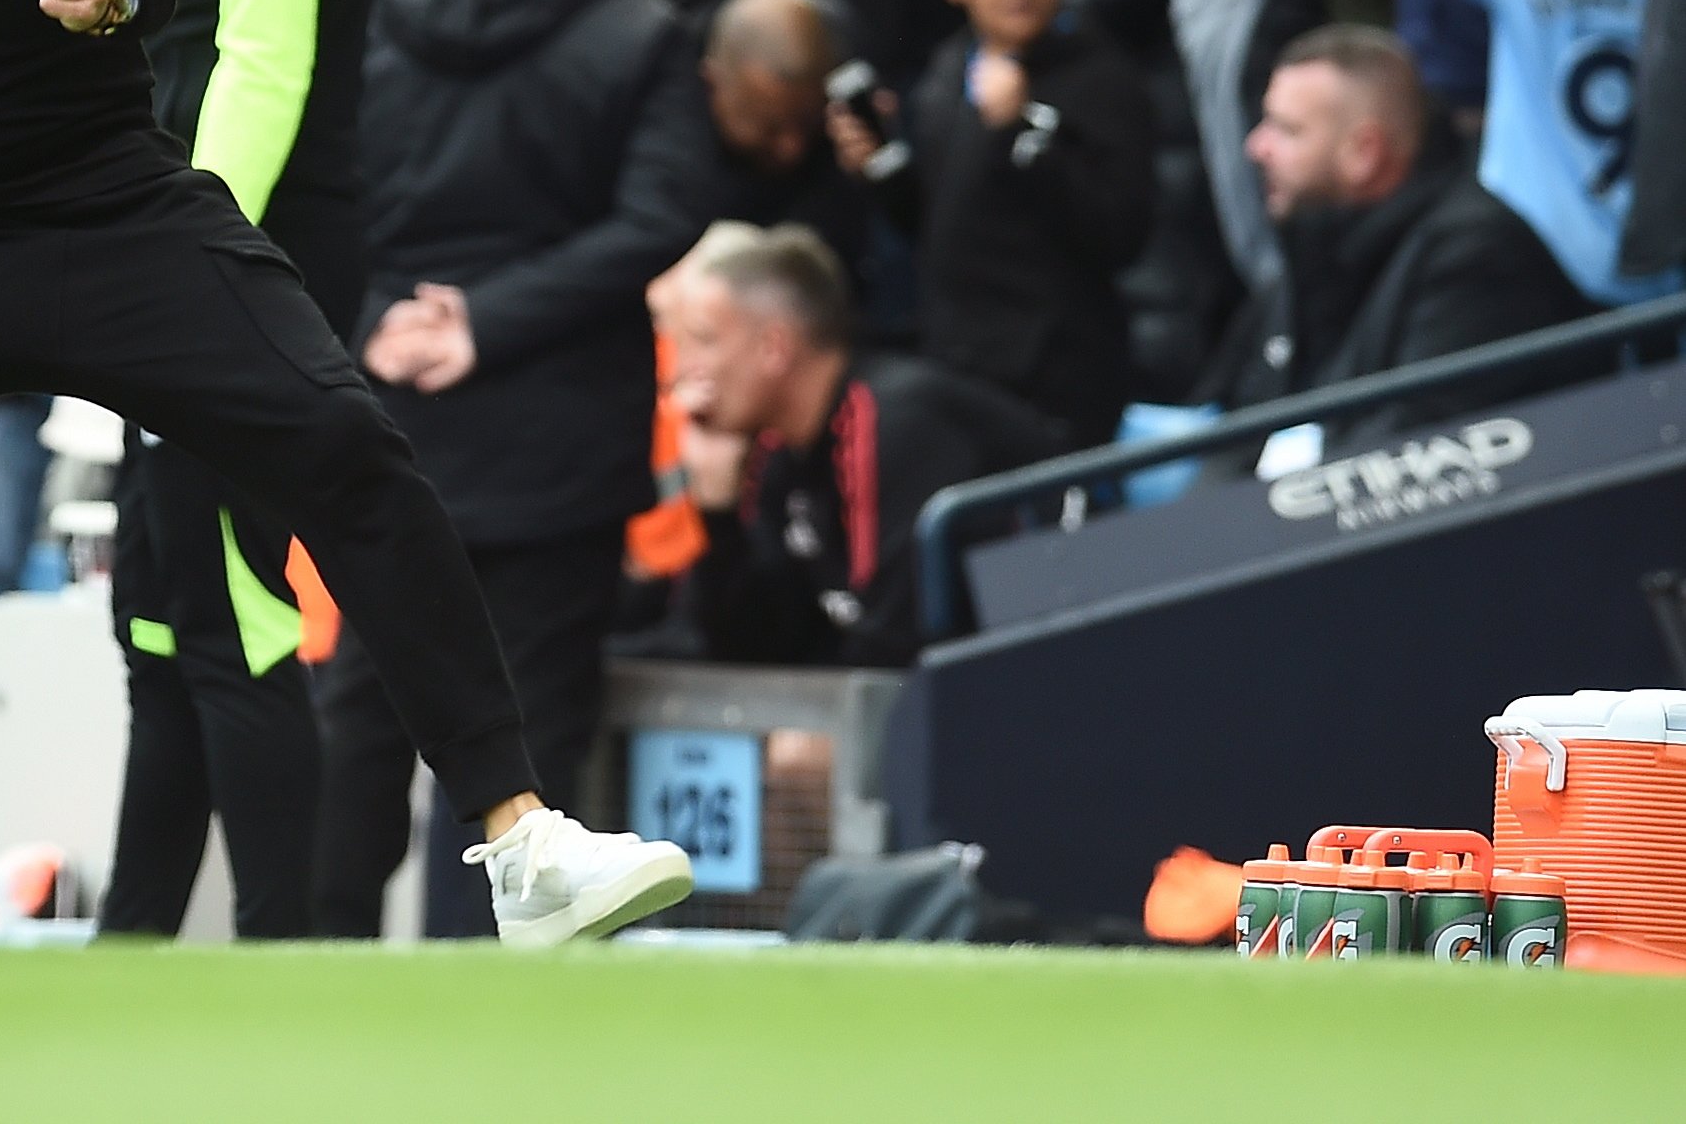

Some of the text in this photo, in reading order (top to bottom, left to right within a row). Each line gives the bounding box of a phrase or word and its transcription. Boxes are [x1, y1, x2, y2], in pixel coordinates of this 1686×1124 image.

[1564, 48, 1639, 196] 9
[1268, 417, 1533, 520] ETIHAD
[1434, 924, 1481, 963] G
[1506, 927, 1555, 968] G
